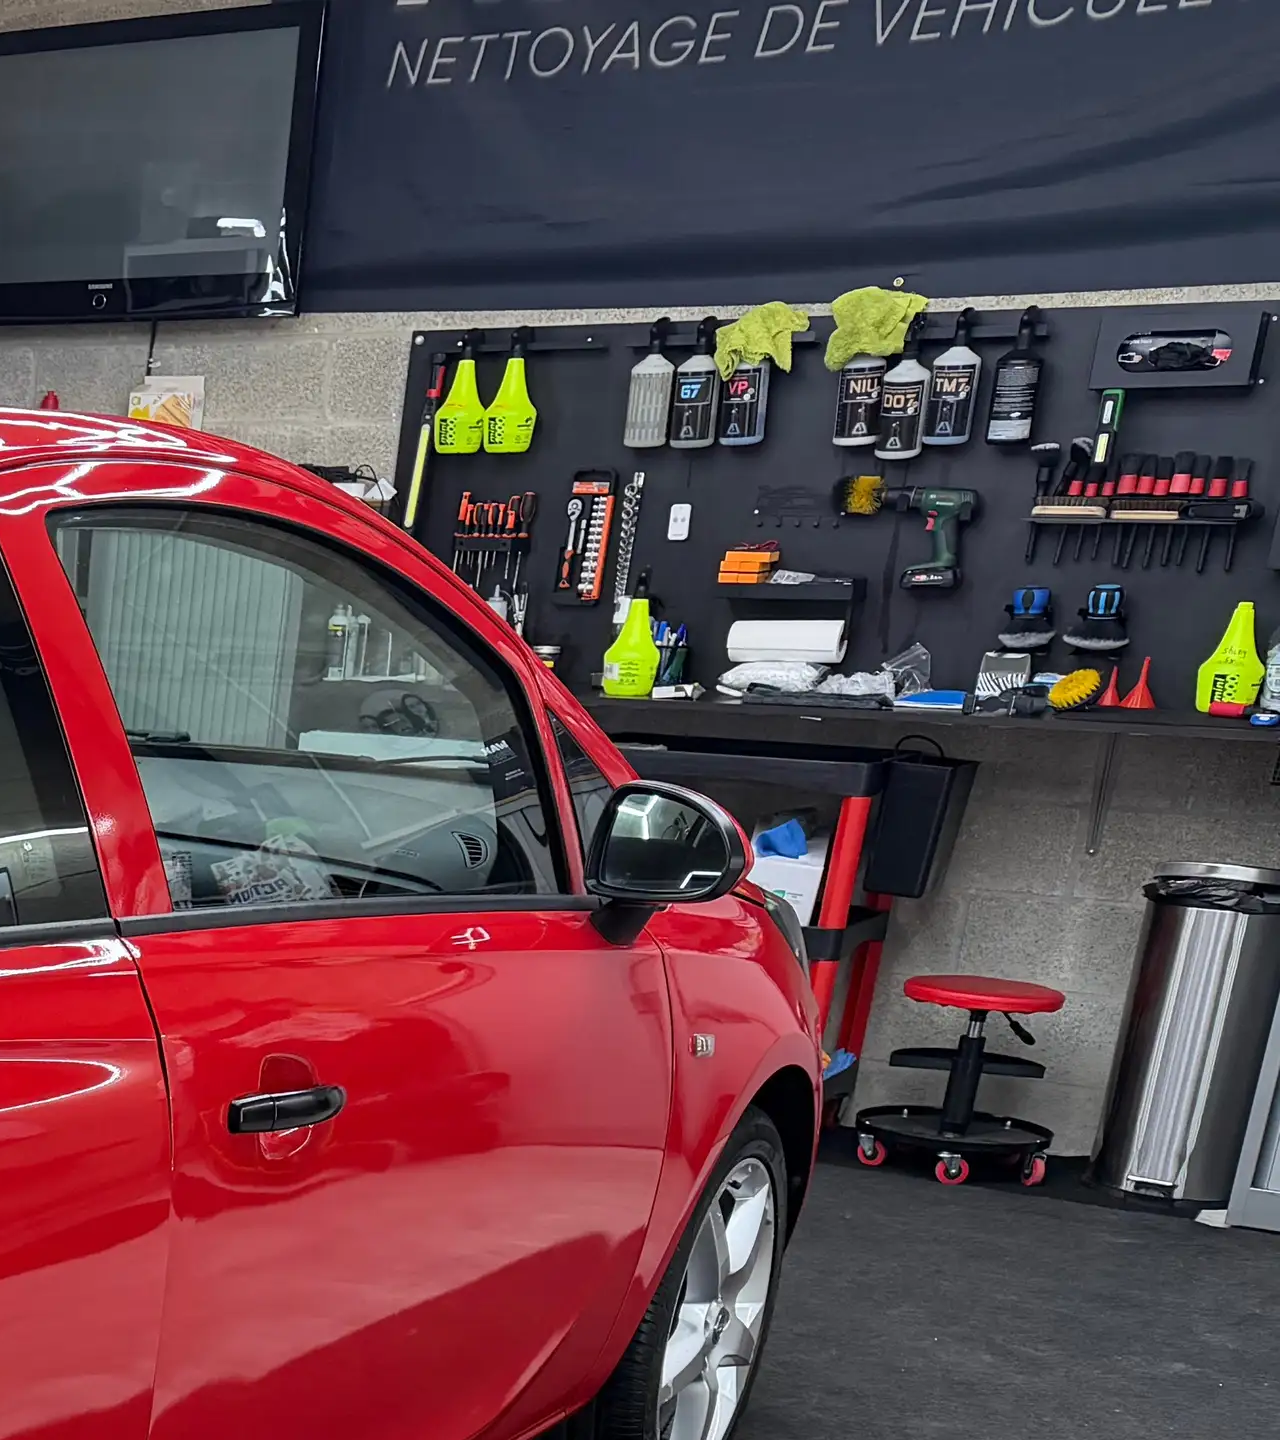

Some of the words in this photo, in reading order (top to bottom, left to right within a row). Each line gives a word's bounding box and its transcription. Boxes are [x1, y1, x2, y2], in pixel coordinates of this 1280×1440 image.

[387, 10, 740, 88] NETTOYAGE
[754, 0, 841, 58] DE
[728, 380, 749, 395] VP
[849, 378, 878, 394] NIU
[935, 377, 969, 393] TM7
